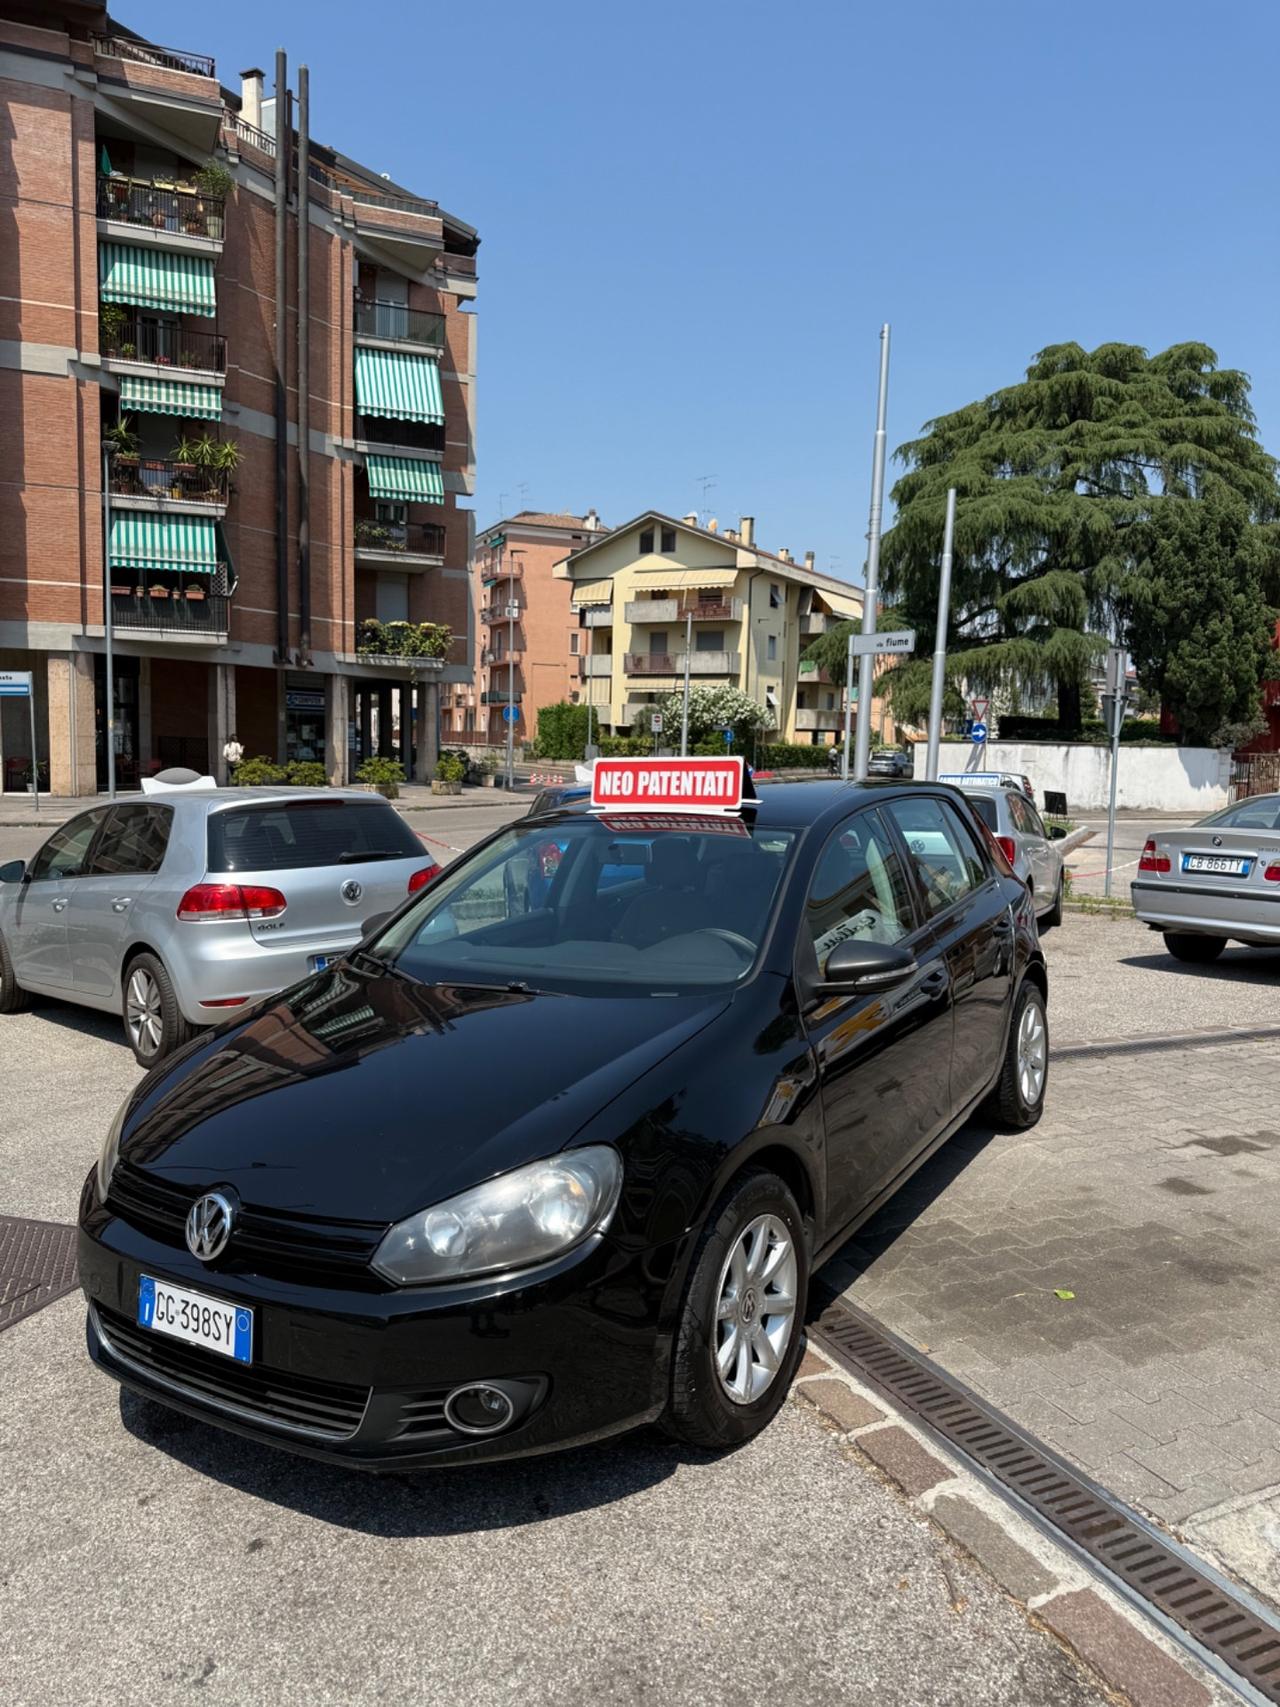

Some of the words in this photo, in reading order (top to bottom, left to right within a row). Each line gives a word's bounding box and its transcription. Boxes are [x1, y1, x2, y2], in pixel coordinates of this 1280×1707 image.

[886, 638, 909, 647] fiume
[600, 771, 634, 796] NEO
[637, 771, 734, 797] PATENTATI
